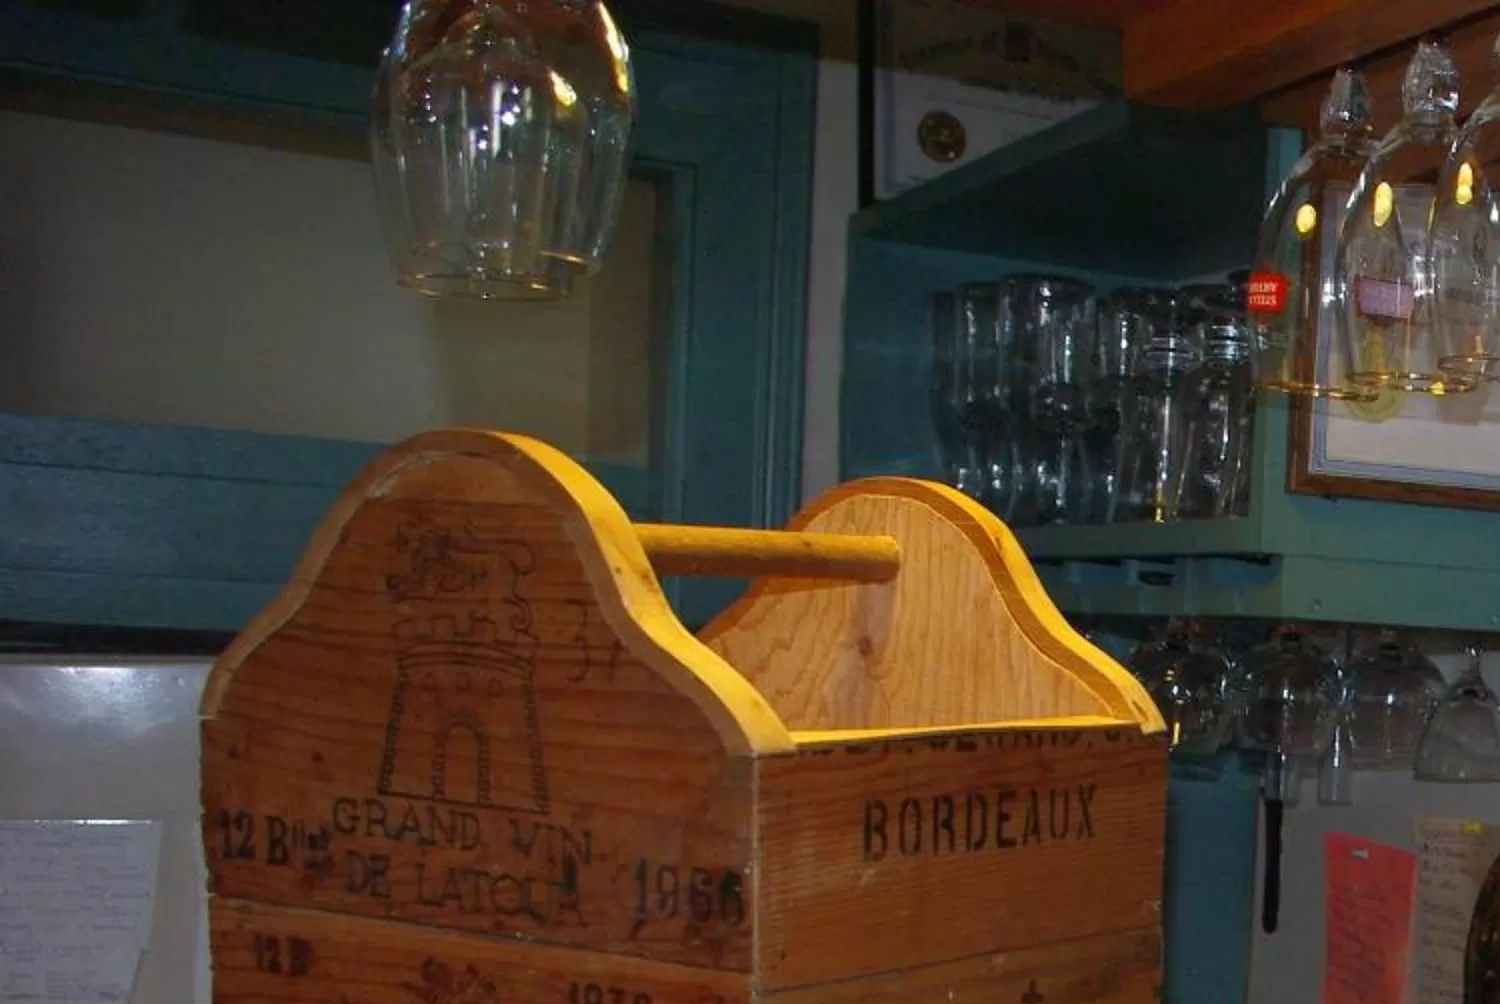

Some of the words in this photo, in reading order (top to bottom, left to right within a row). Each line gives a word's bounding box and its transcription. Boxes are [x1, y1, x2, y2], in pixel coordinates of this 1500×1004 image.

[333, 797, 481, 852] GRAND
[509, 817, 594, 866] VIN
[863, 783, 1097, 862] BORDEAUX
[344, 849, 393, 898] DE
